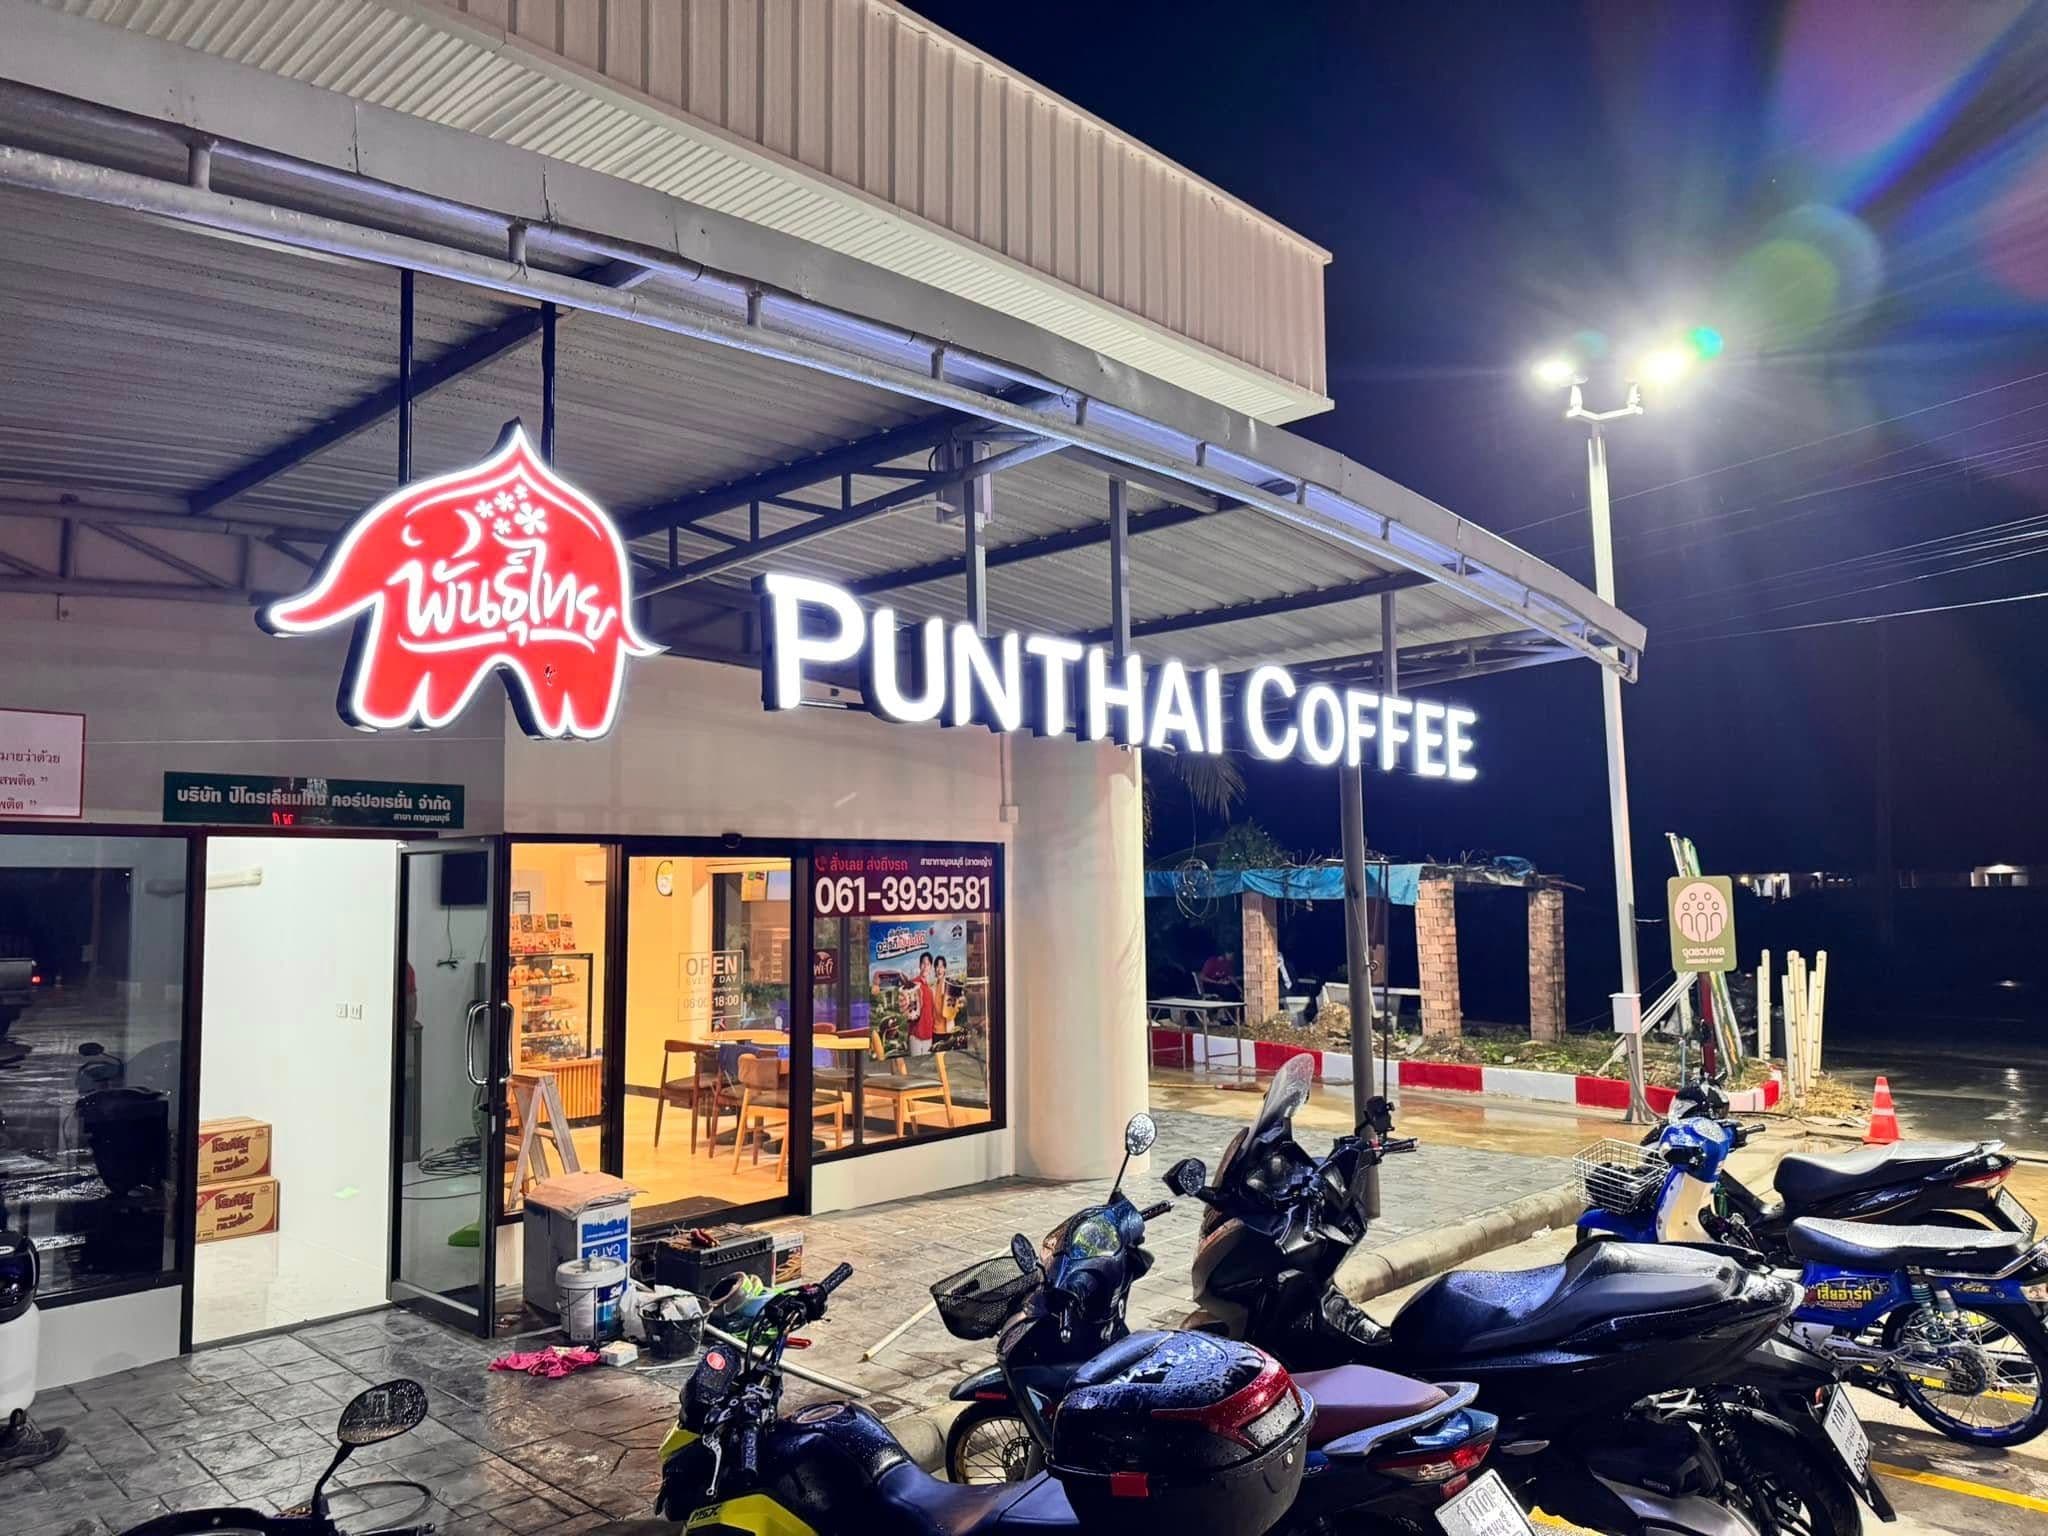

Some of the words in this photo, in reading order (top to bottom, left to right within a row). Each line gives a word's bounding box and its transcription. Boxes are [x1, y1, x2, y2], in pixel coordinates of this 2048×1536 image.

[387, 532, 616, 647] พันธุ์ไทย
[177, 786, 222, 803] บริษัท
[418, 794, 452, 811] จำกัด
[830, 853, 863, 871] สั่งเลย
[815, 875, 990, 914] 061-3935581
[686, 955, 738, 976] OPEN
[719, 975, 737, 983] DAY
